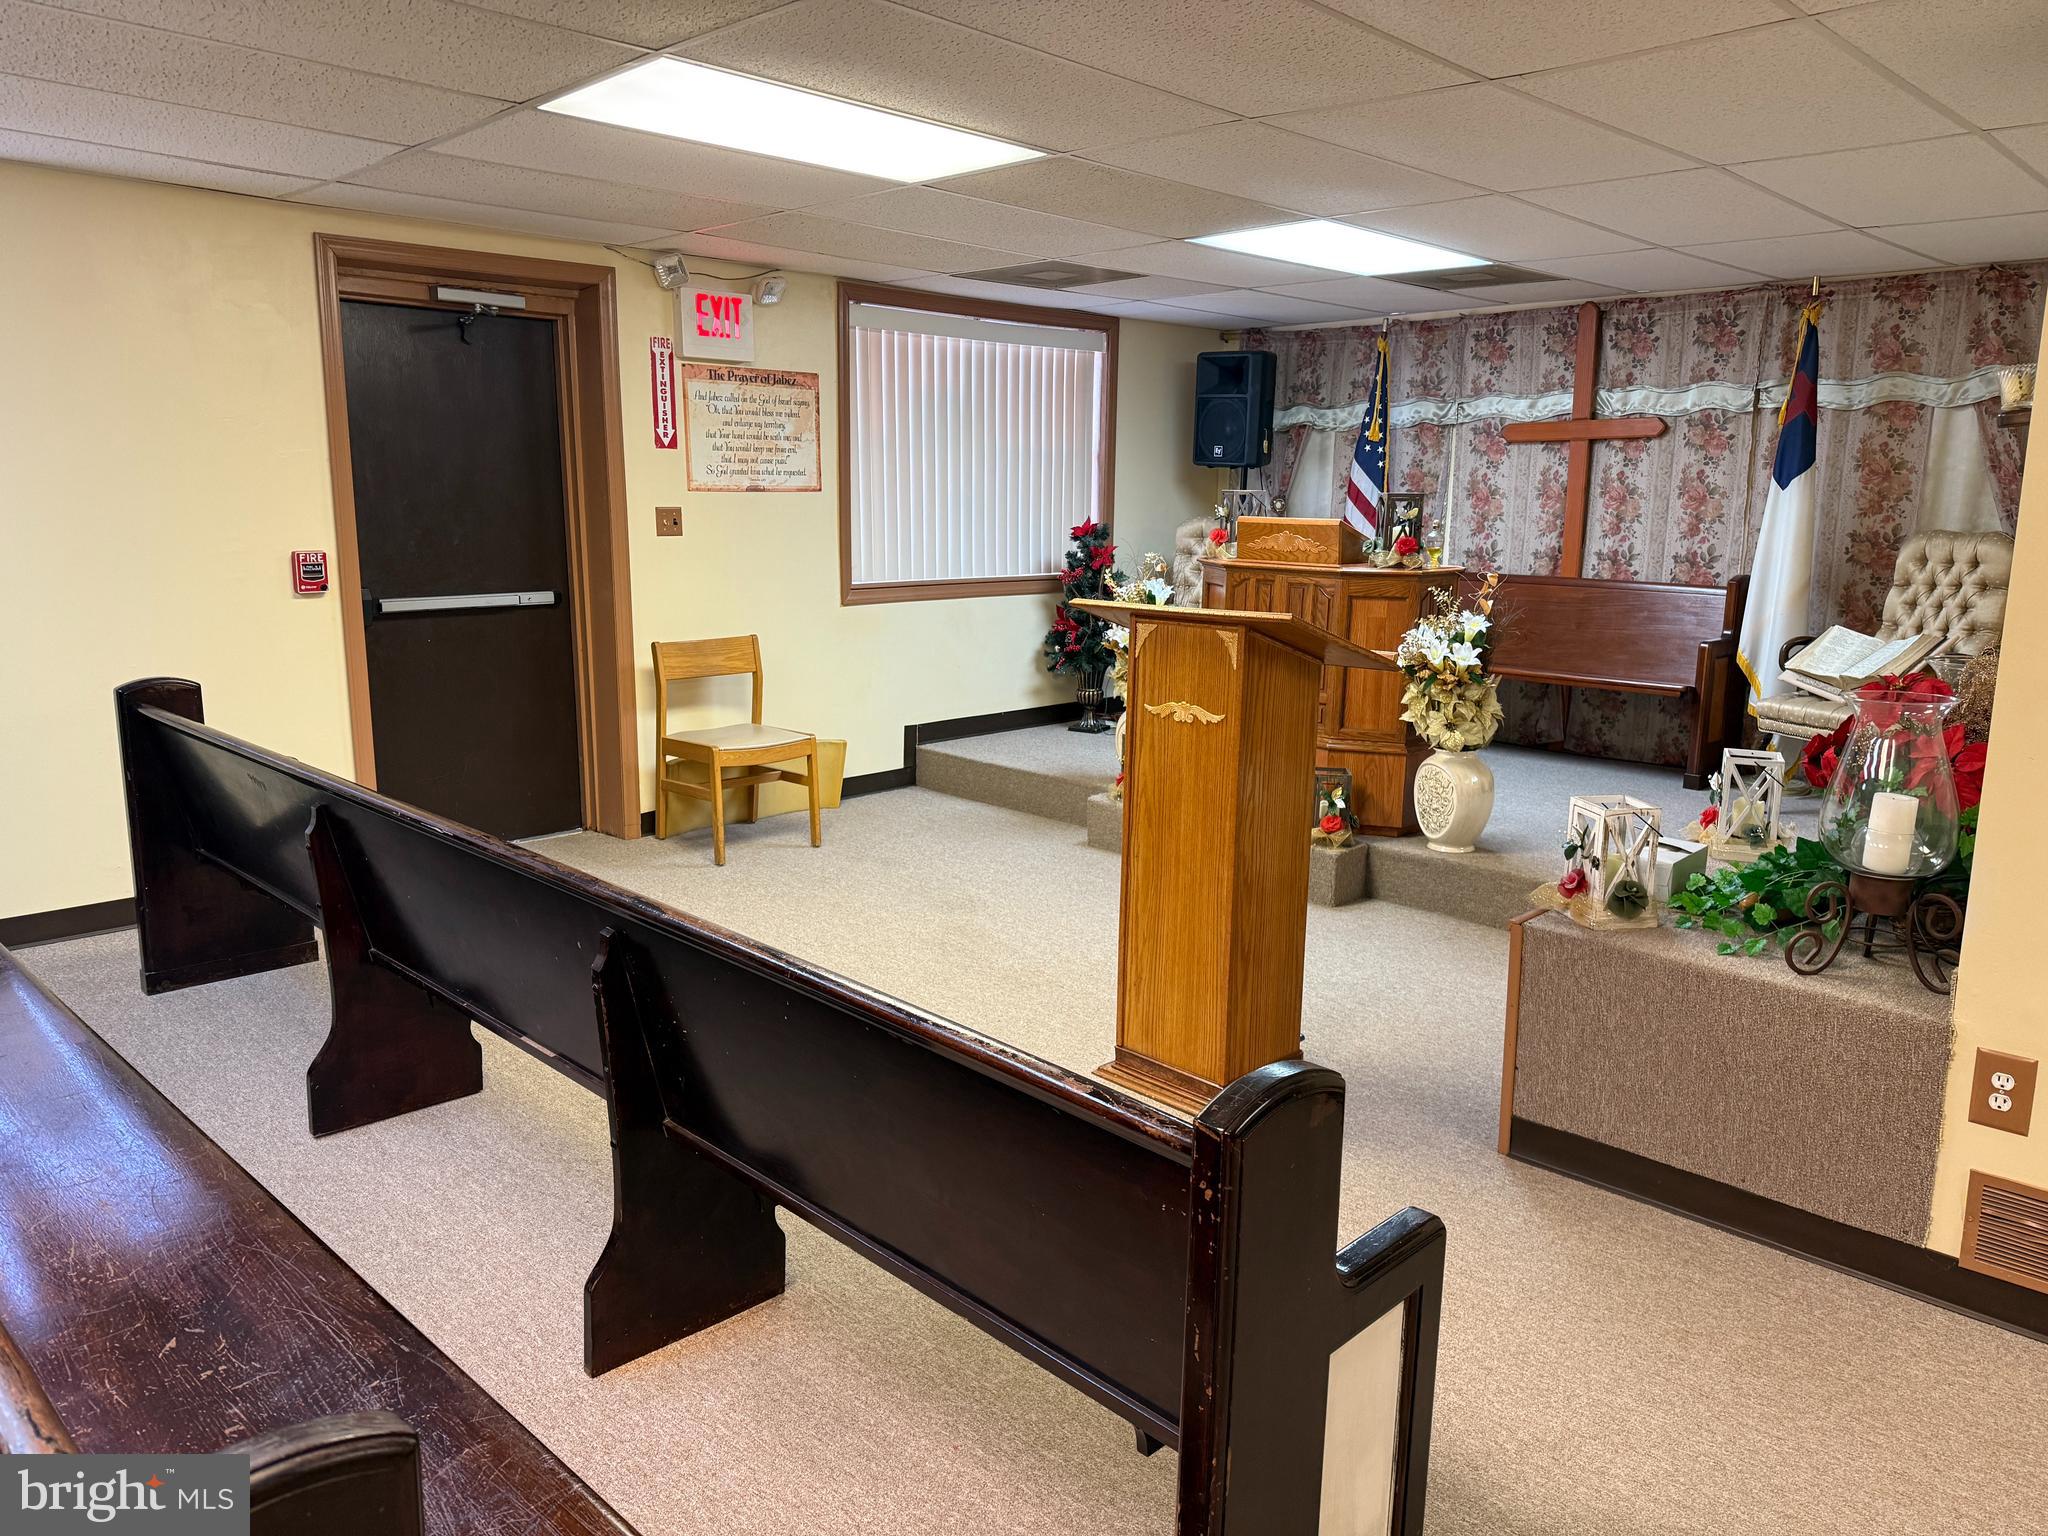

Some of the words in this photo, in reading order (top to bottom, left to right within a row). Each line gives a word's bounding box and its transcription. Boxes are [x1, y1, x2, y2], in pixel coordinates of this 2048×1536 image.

[695, 293, 742, 339] EXIT
[652, 337, 671, 350] FIRE
[707, 368, 725, 381] The
[727, 370, 759, 385] Prayer
[760, 374, 772, 385] of
[771, 374, 797, 386] Jabez
[659, 351, 669, 439] EXTINGUISHER
[721, 405, 733, 415] that
[761, 407, 775, 417] bless
[705, 428, 717, 439] that
[300, 553, 324, 563] FIRE
